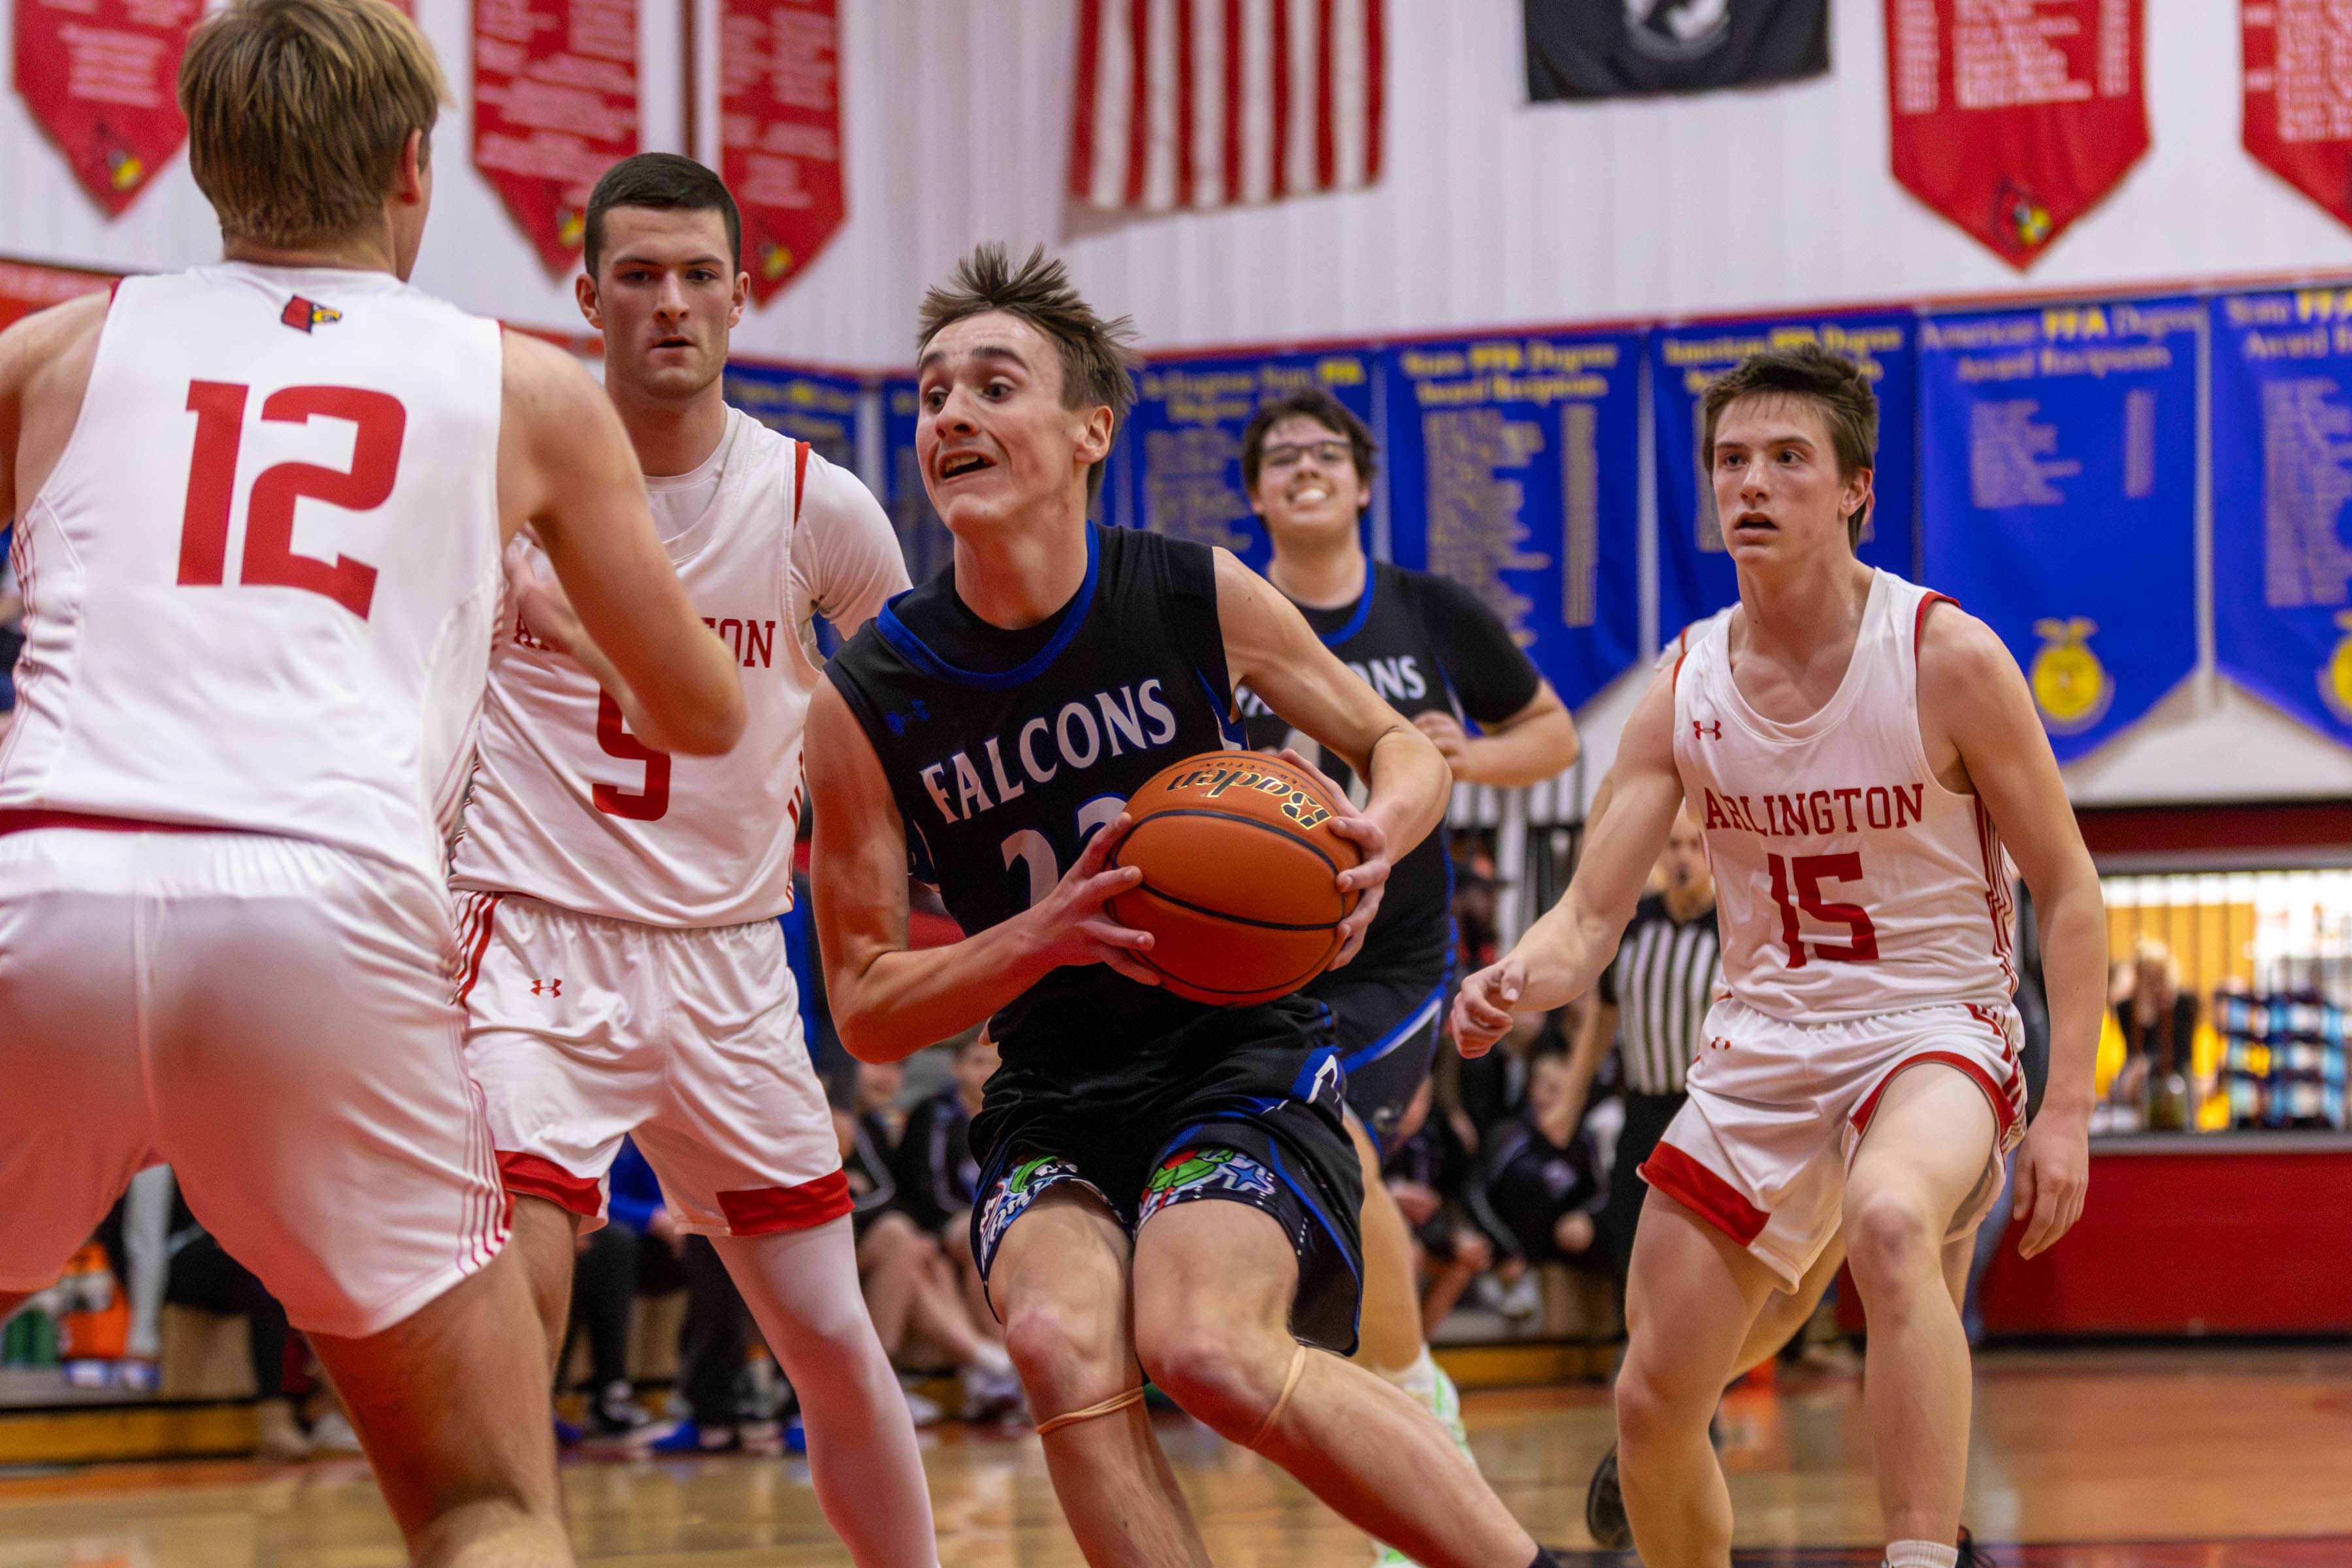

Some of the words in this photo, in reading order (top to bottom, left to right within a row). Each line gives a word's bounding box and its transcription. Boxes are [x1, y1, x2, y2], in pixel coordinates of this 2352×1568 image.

[2042, 306, 2109, 340] FFA
[176, 378, 406, 621] 12
[919, 678, 1177, 825] FALCONS
[1166, 768, 1333, 830] Baden
[1704, 783, 1924, 836] ARLINGTON
[1767, 851, 1880, 968] 15
